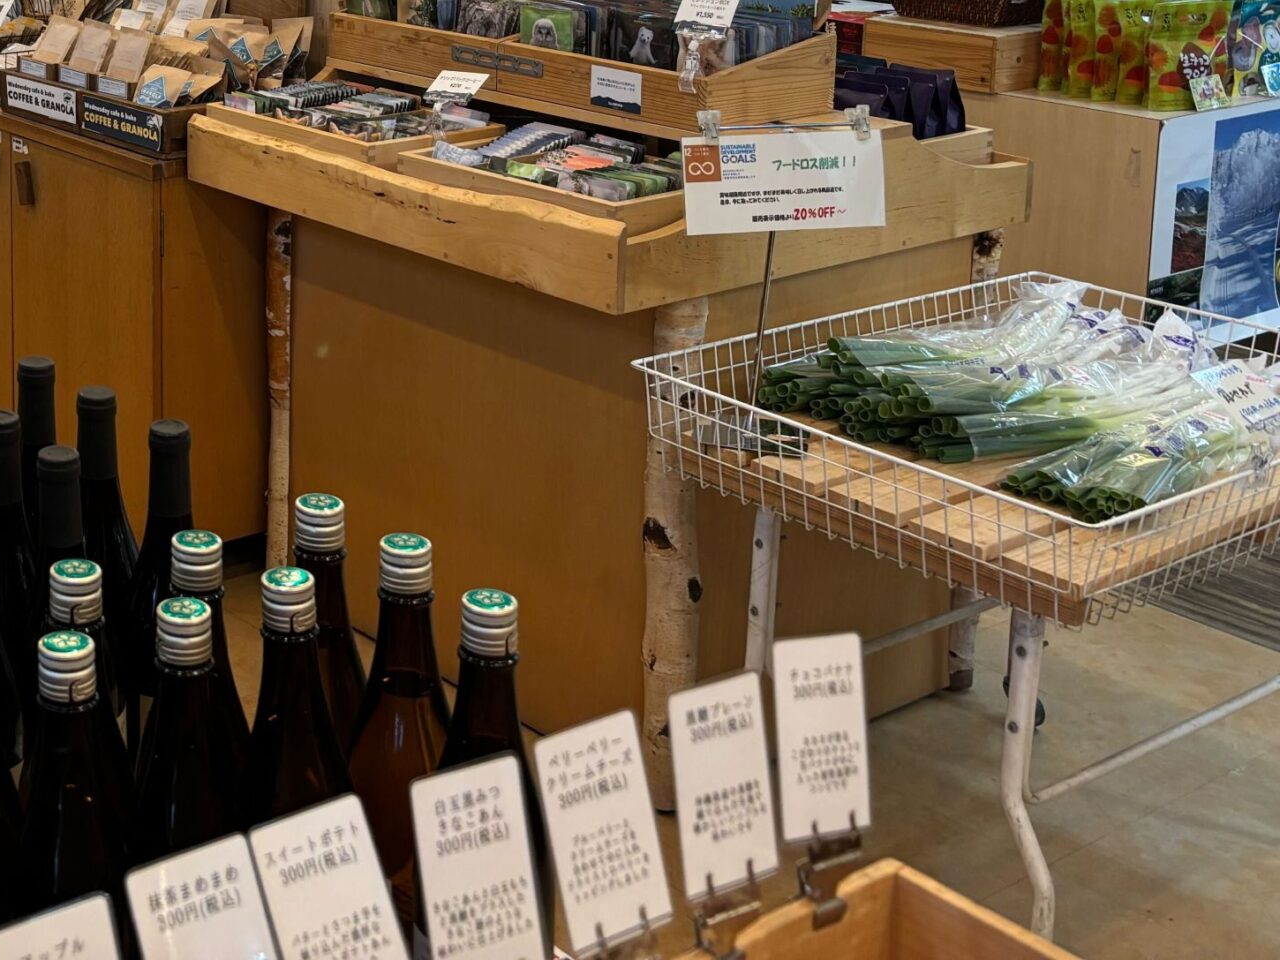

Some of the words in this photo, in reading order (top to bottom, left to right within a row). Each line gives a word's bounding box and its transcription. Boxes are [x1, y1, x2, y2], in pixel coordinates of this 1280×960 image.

[1180, 52, 1210, 67] 生チョコ
[8, 81, 32, 93] Wednesday
[8, 90, 33, 105] COFFEE
[34, 96, 40, 106] &
[40, 98, 75, 117] GRANOLA
[84, 101, 110, 116] Wednesday
[84, 111, 112, 128] COFFEE
[112, 119, 119, 131] &
[120, 121, 158, 142] GRANOLA
[721, 154, 757, 164] GOALS
[793, 680, 854, 701] 300円(税込)
[690, 712, 754, 744] 300円(税込)
[548, 736, 623, 768] ベリーベリー
[546, 747, 634, 794] クリームチーズ
[558, 771, 629, 810] 300円(税込)
[437, 803, 504, 835] きなこあん
[263, 820, 360, 868] スイートポテト
[436, 821, 511, 858] 300円(税込)
[279, 846, 361, 887] 300円(税込)
[147, 863, 239, 914] 抹茶まめまめ
[156, 886, 242, 934] 300円(税込)
